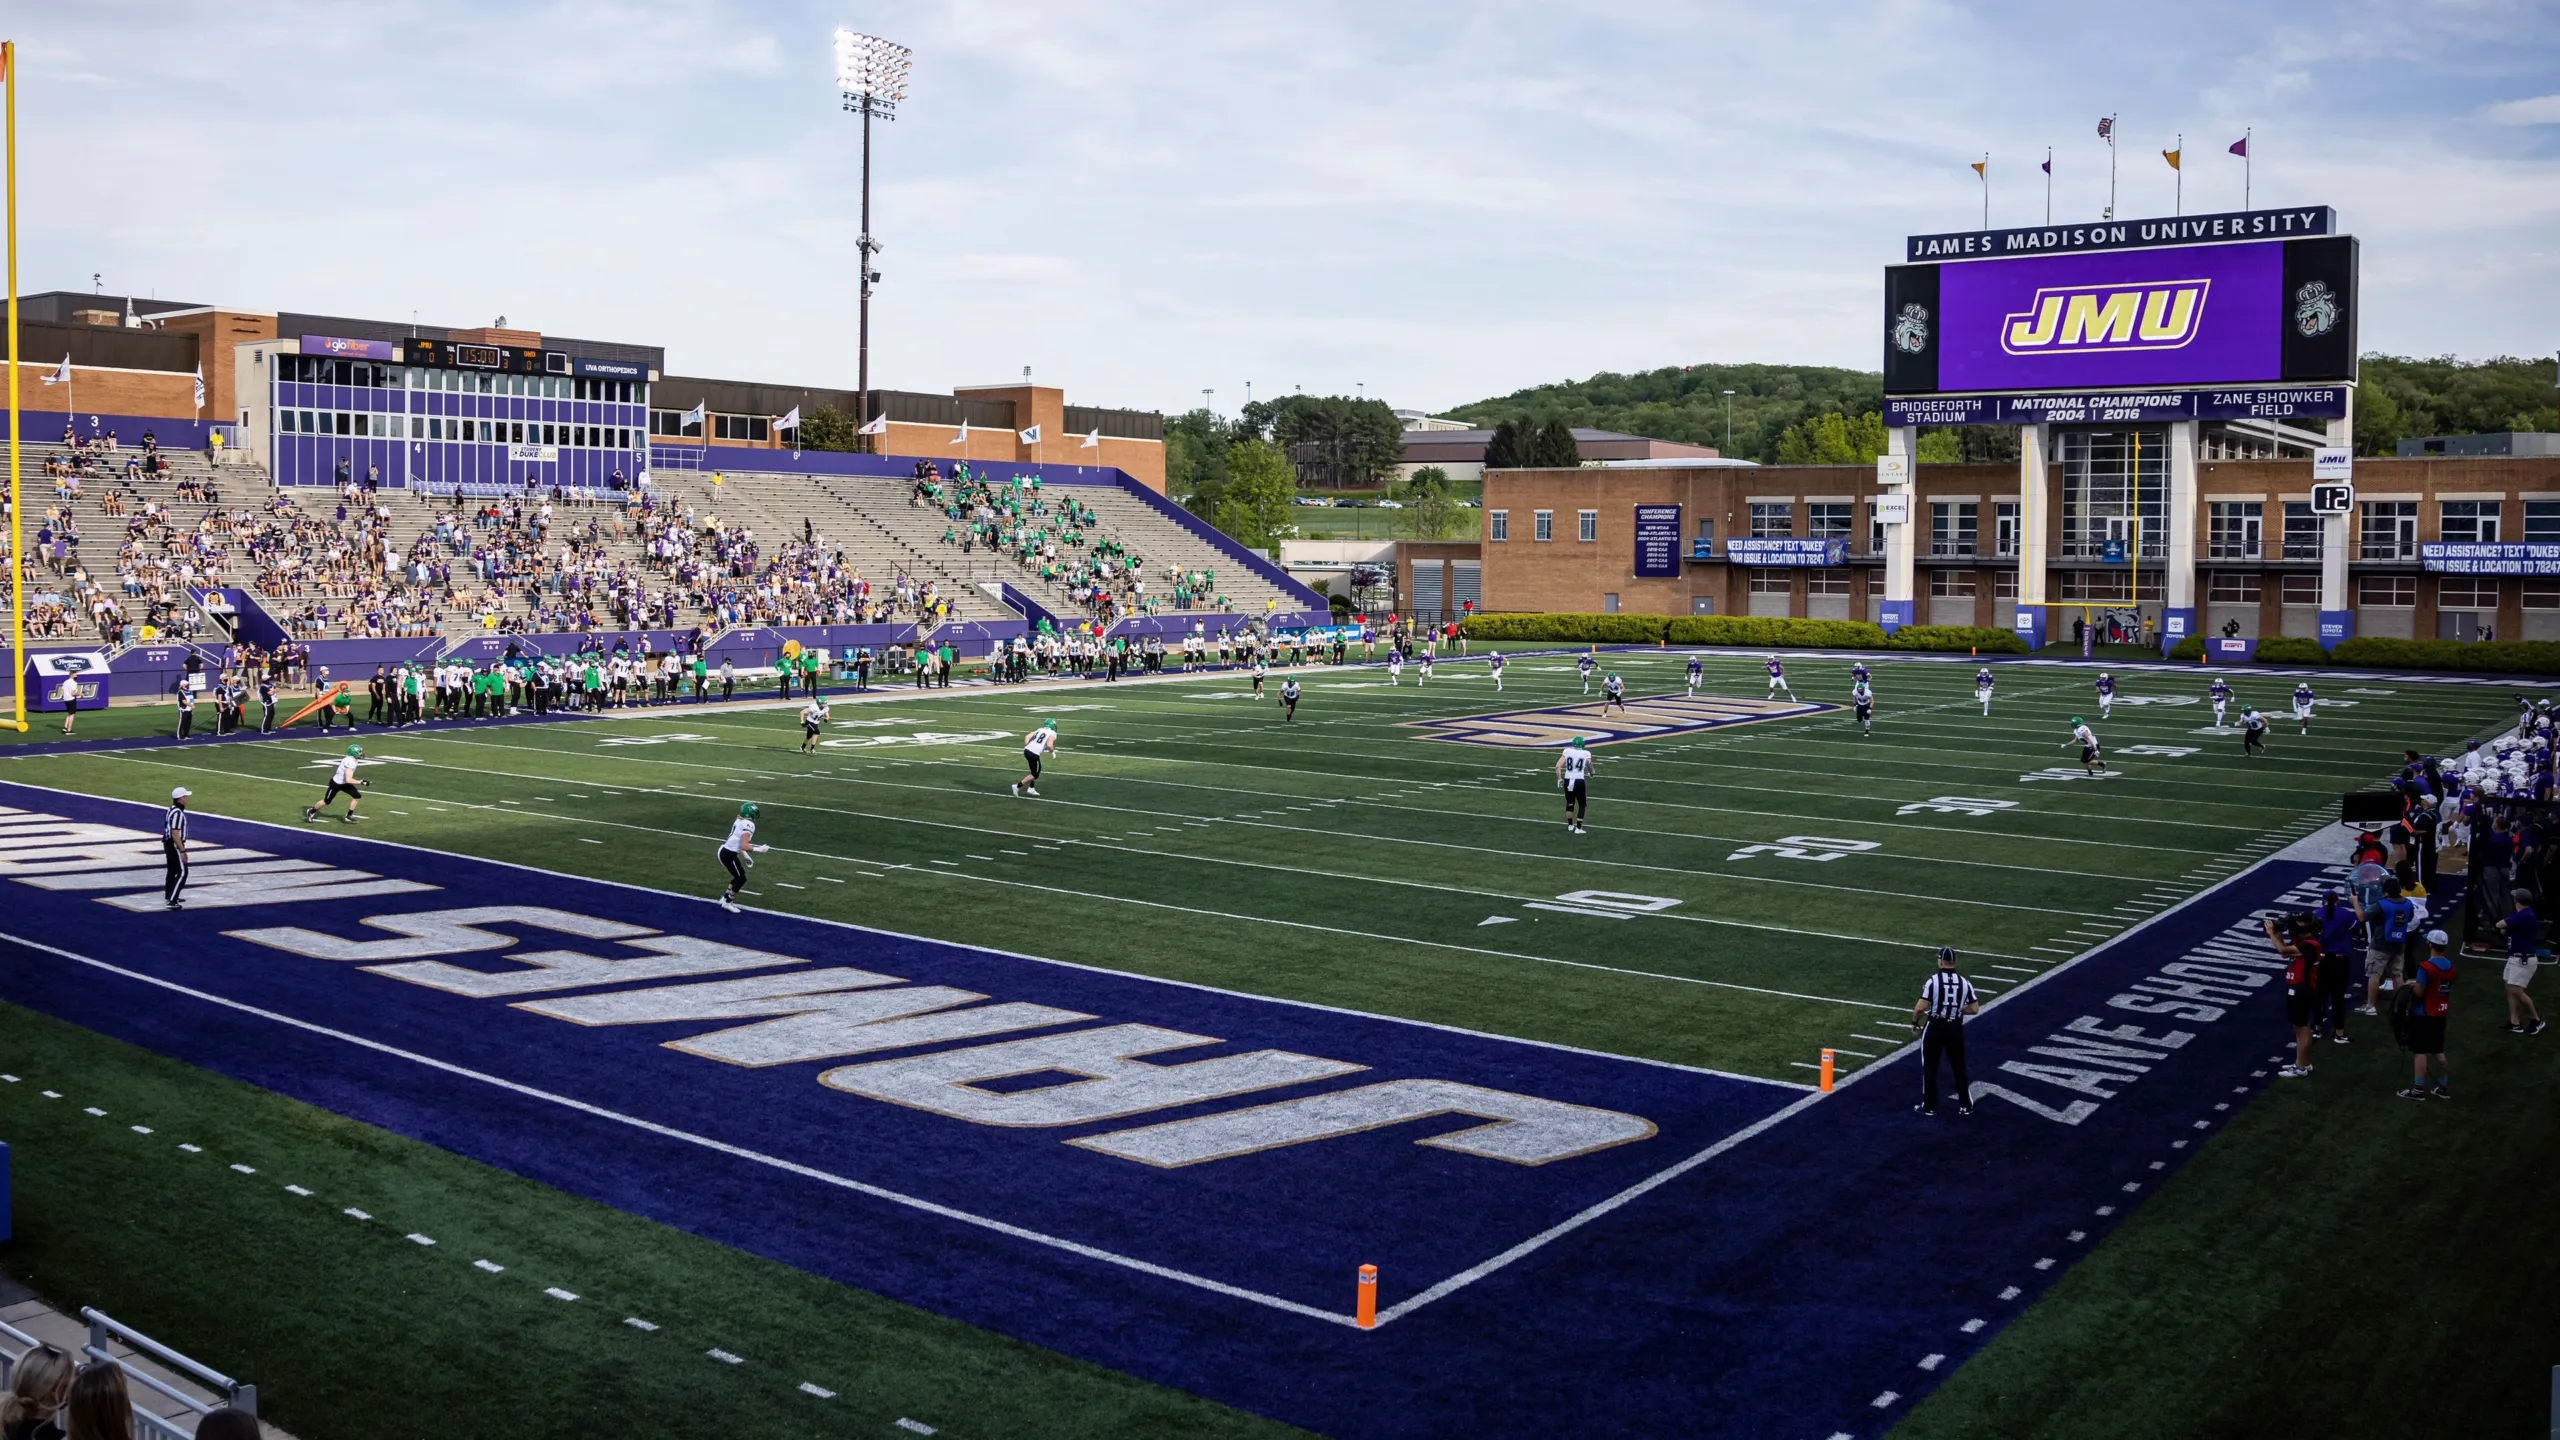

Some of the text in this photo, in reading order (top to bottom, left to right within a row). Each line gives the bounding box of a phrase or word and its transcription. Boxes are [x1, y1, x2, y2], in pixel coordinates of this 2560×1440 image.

[1915, 212, 2316, 257] JAMES MADISON UNIVERSITY
[2007, 287, 2200, 348] JMU
[418, 341, 432, 349] JMU
[428, 352, 453, 365] 0 3
[465, 349, 495, 364] 15:00
[503, 360, 532, 370] 3 0
[585, 364, 638, 375] UVA ORTHOPEDICS
[2011, 394, 2183, 411] NATIONAL CHAMPIONS
[2213, 390, 2334, 405] ZANE SHOWKER
[1891, 399, 1982, 413] BRIDGEFORTH
[2250, 404, 2294, 416] FIELD
[91, 415, 99, 427] 3
[1906, 411, 1966, 423] STADIUM
[2046, 408, 2141, 422] 2004 2016
[414, 442, 421, 454] 4
[635, 453, 642, 463] 5
[2319, 456, 2346, 464] JMU
[2325, 488, 2348, 510] 12
[1727, 540, 1826, 552] NEED ASSISTANCE? TEXT "DUKES"
[2422, 544, 2445, 558] NEED
[2445, 544, 2502, 558] ASSISTANCE?
[2502, 544, 2525, 558] TEXT
[1743, 553, 1761, 564] ISSUE
[1762, 553, 1767, 564] &
[1767, 553, 1796, 564] LOCATION
[1797, 554, 1806, 564] TO
[1806, 554, 1825, 565] 78247
[2424, 560, 2560, 573] YOUR ISSUE & LOCATION TO 78247
[303, 644, 310, 653] 3
[1566, 757, 1584, 772] 84
[1897, 796, 2020, 816] 30
[1733, 835, 1883, 862] 20
[1521, 889, 1684, 920] 10
[1943, 984, 1959, 1006] H
[220, 904, 1660, 1168] JAMES
[1950, 1015, 2197, 1127] ZANE
